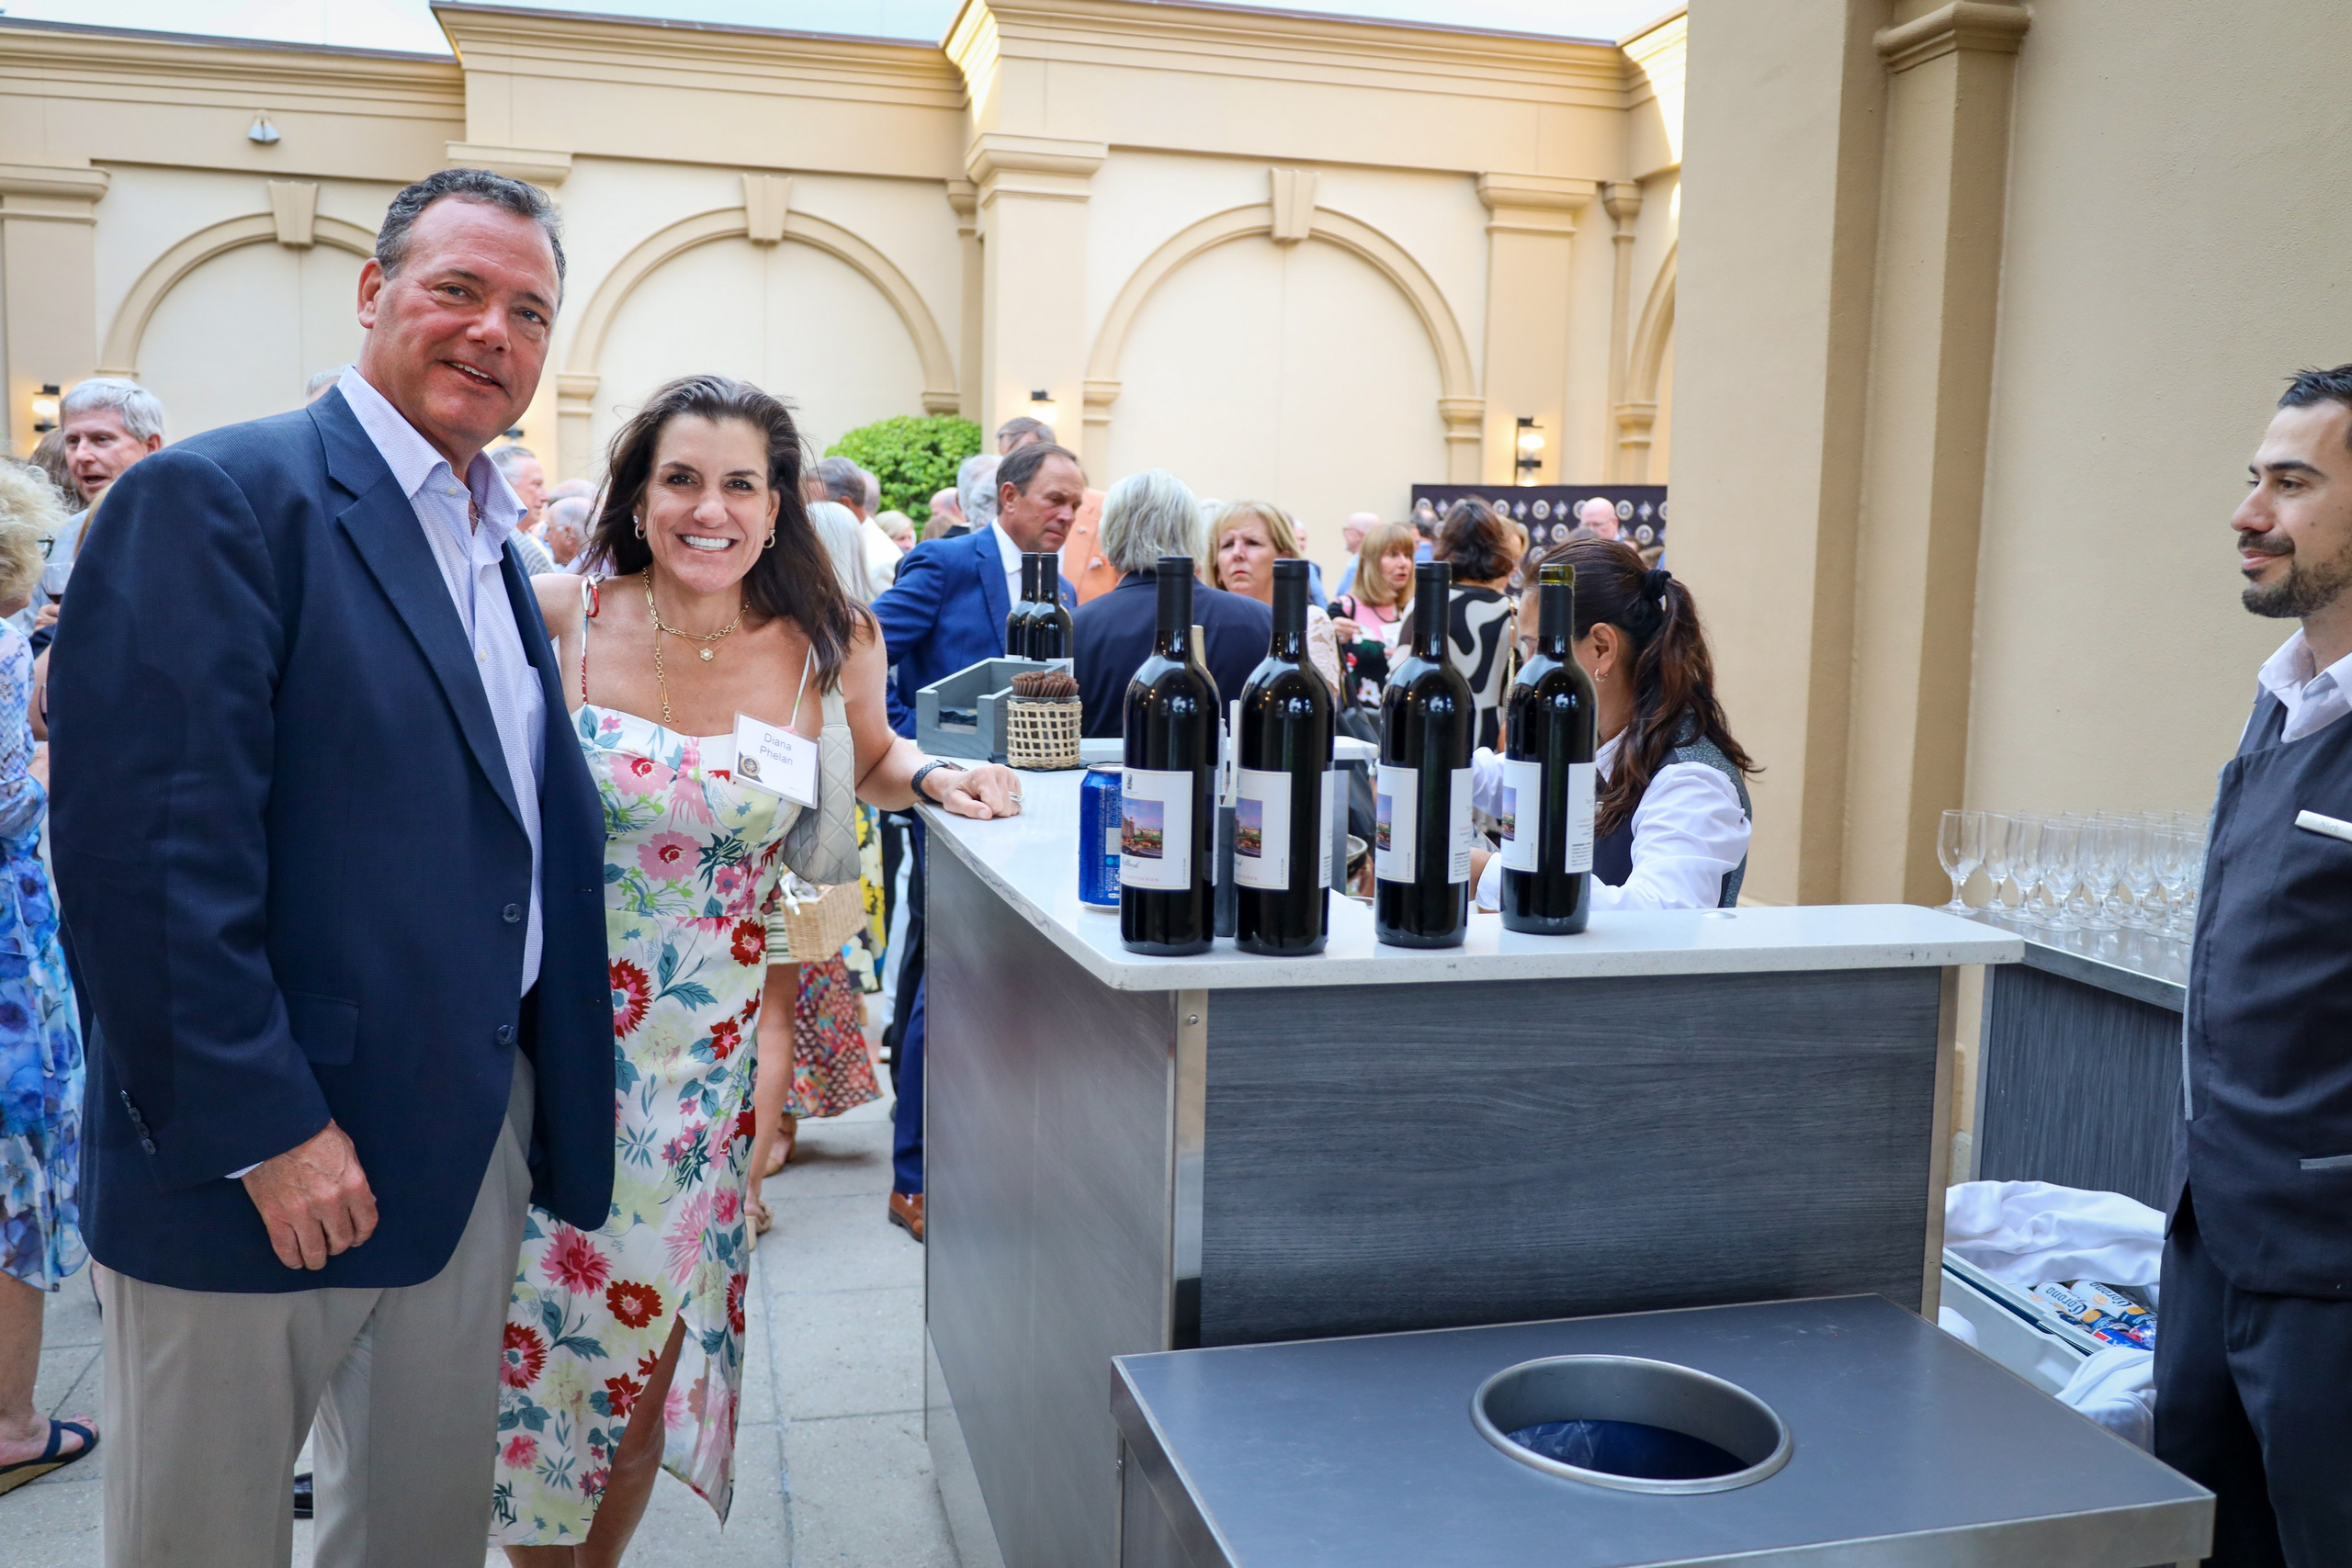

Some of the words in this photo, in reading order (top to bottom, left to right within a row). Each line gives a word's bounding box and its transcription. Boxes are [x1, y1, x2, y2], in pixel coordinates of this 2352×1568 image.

[763, 732, 792, 751] Diana
[760, 745, 793, 766] Phelan
[2045, 1286, 2087, 1315] Corona
[2089, 1281, 2132, 1307] Corona
